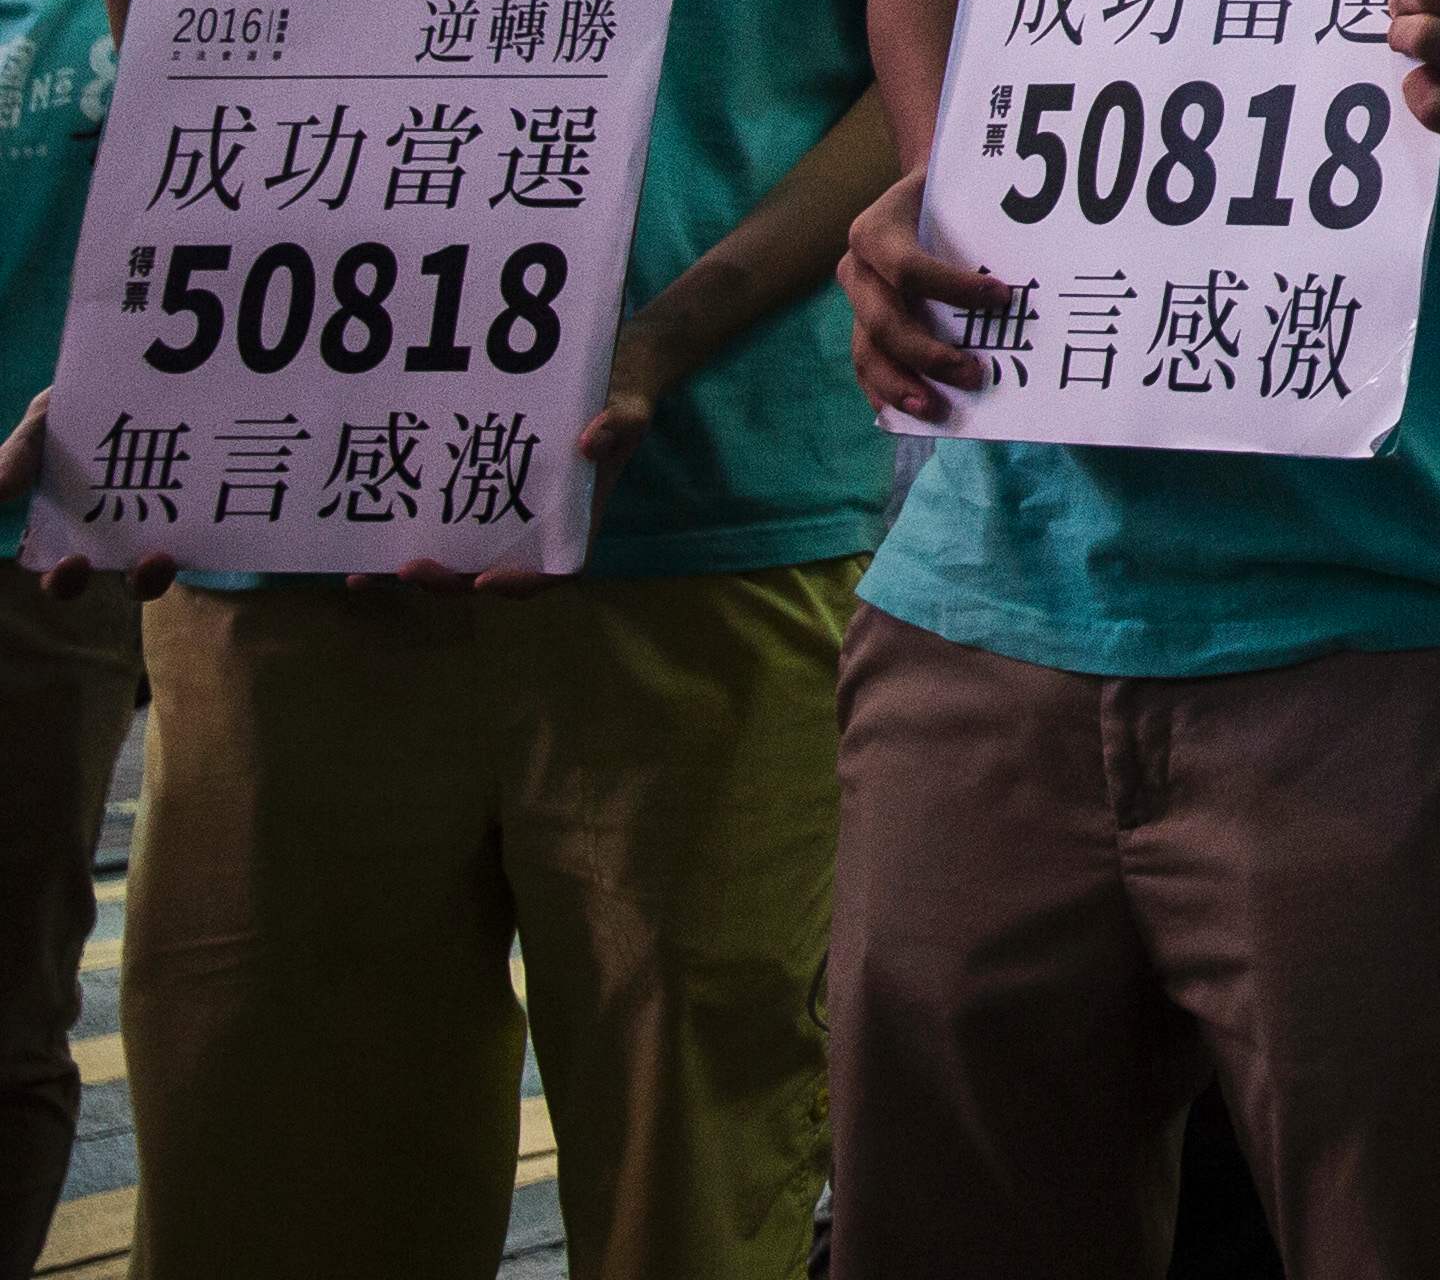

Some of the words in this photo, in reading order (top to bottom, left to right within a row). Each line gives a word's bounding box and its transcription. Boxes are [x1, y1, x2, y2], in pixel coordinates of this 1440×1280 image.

[172, 8, 263, 43] 2016
[146, 102, 598, 214] 成功當選
[980, 84, 1013, 158] 得票
[999, 80, 1393, 229] 50818
[121, 245, 154, 313] 得票
[143, 240, 569, 376] 50818
[82, 410, 542, 527] 無言感激
